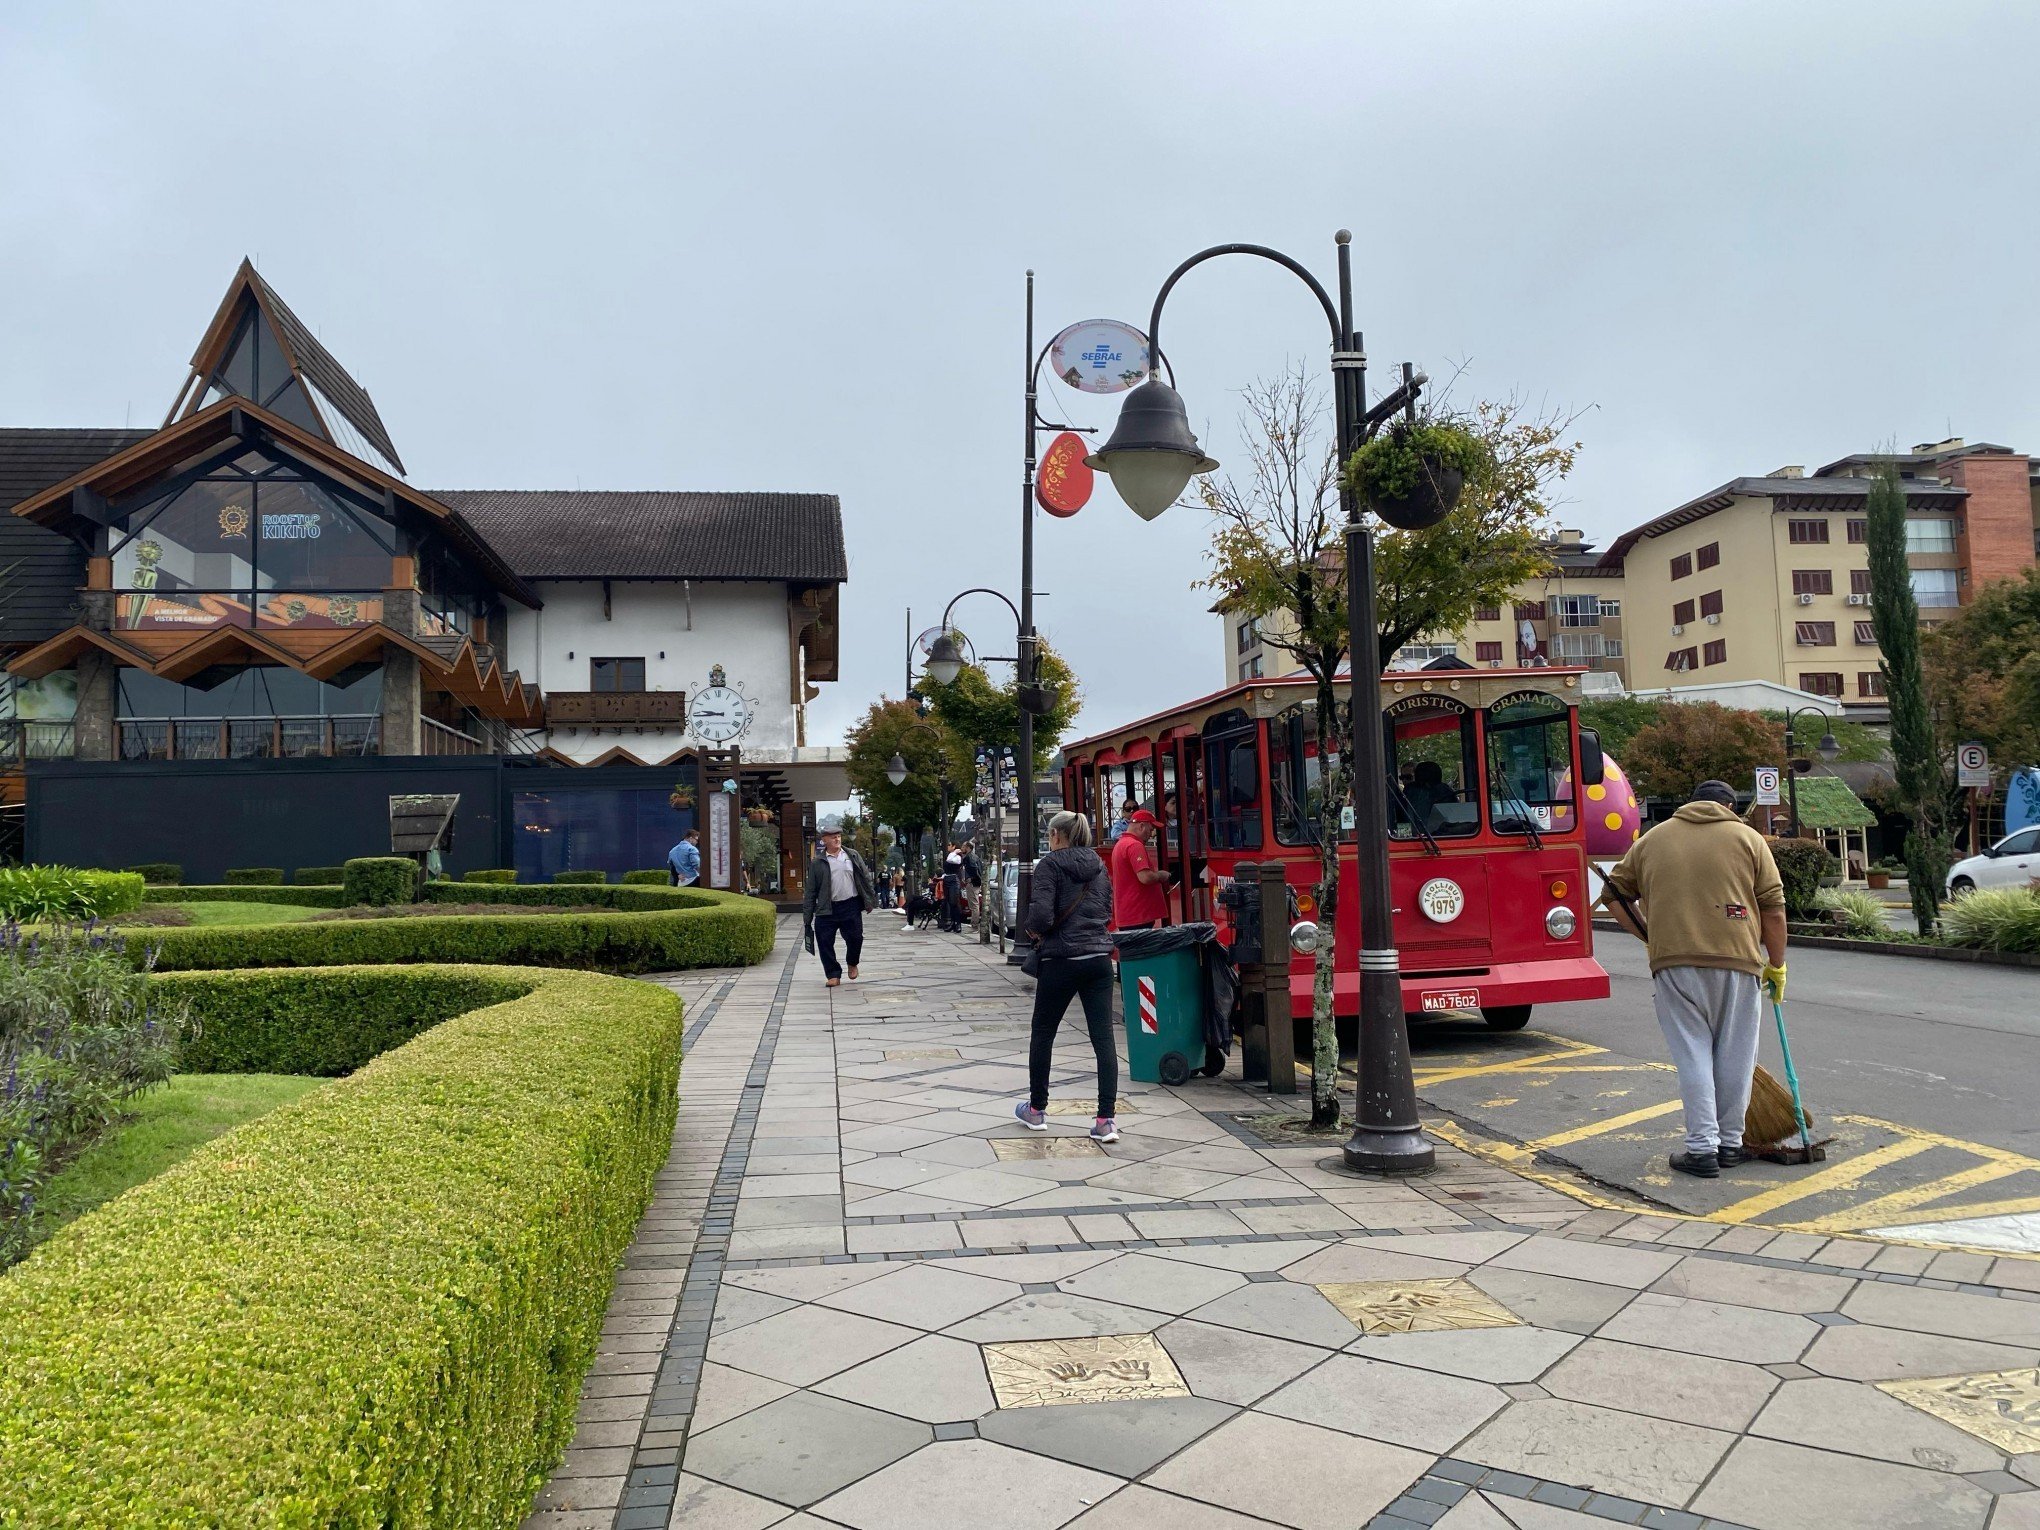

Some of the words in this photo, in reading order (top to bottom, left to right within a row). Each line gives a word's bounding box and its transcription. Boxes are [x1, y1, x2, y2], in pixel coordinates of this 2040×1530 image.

[1081, 352, 1122, 361] SEBRAE
[262, 514, 320, 525] ROOFTOP
[262, 525, 321, 539] KIKITO
[1386, 696, 1466, 717] TURISTICO
[1490, 693, 1561, 713] GRAMADO
[1969, 751, 1978, 765] E
[1764, 776, 1772, 788] E
[1425, 882, 1461, 903] TROLLIBUS
[1430, 900, 1455, 915] 1979
